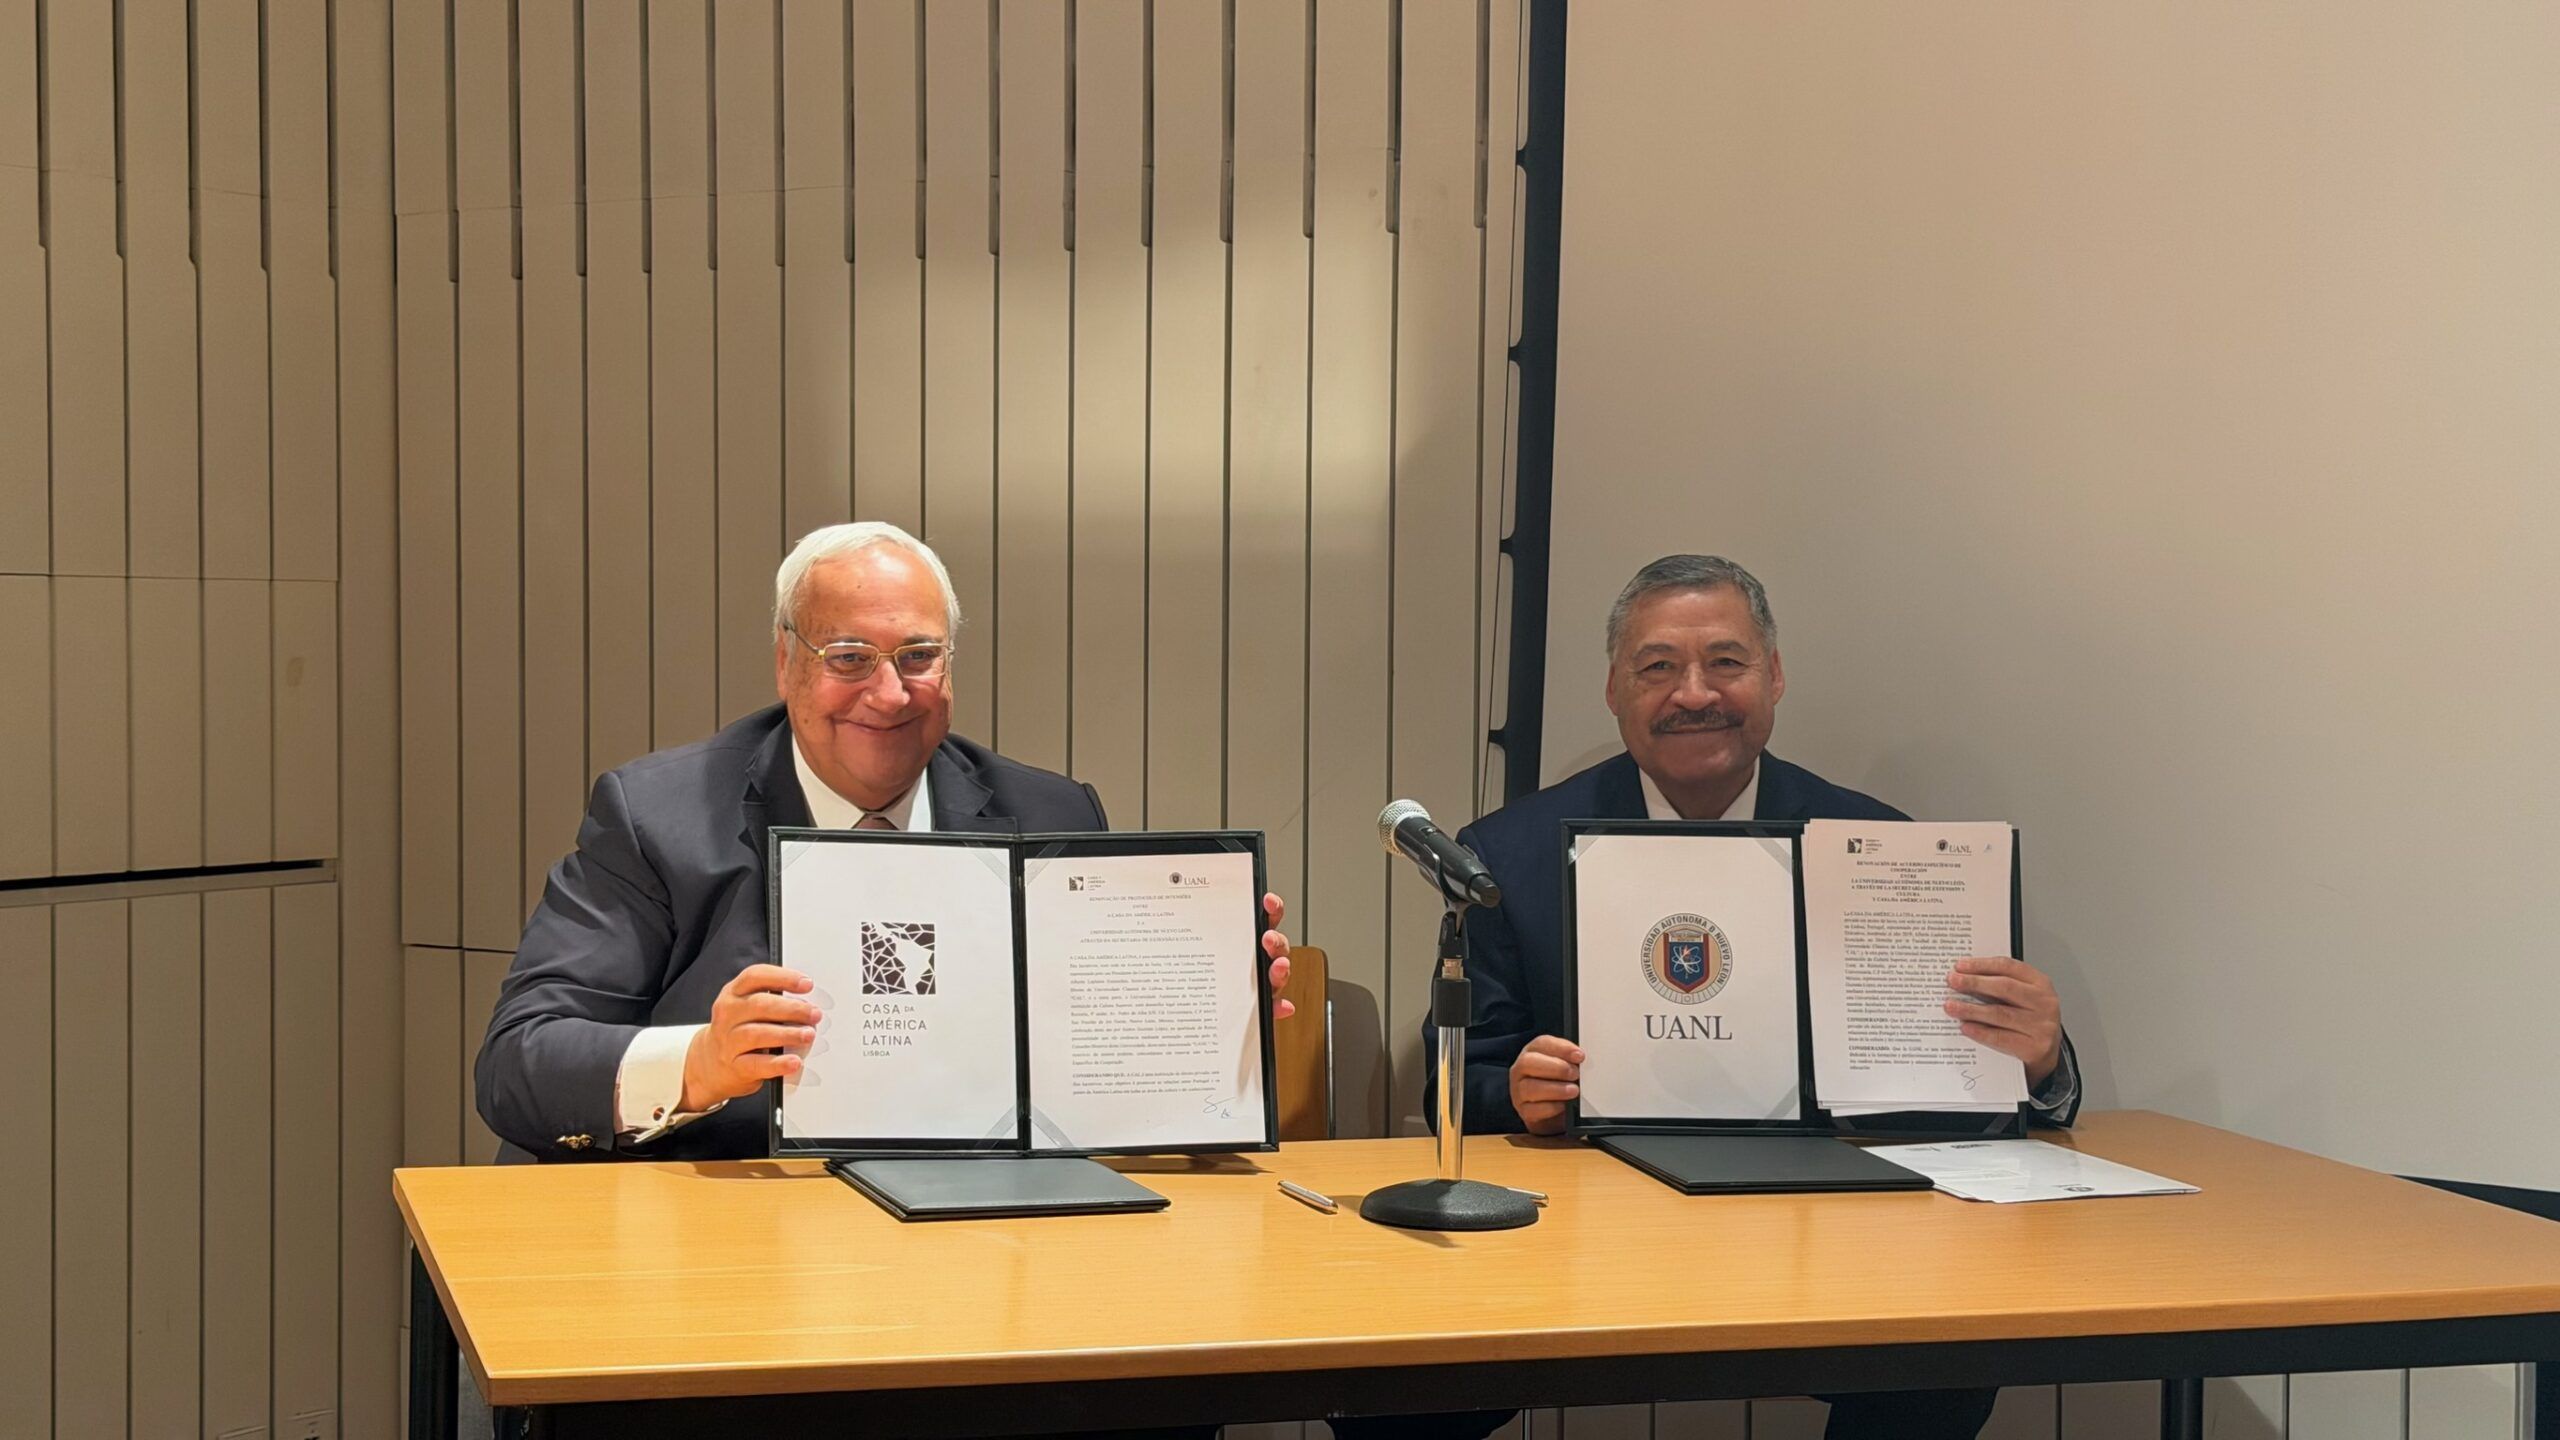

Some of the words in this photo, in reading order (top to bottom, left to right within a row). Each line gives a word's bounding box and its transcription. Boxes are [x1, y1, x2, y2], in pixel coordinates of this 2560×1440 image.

[1949, 845, 1972, 853] UANL
[1184, 876, 1210, 886] UANL
[1643, 927, 1661, 984] UNIVERSIDAD
[1714, 932, 1730, 960] NUEVO
[862, 1004, 900, 1014] CASA
[863, 1017, 927, 1030] AMÉRICA
[1644, 1014, 1733, 1040] UANL
[862, 1035, 912, 1046] LATINA
